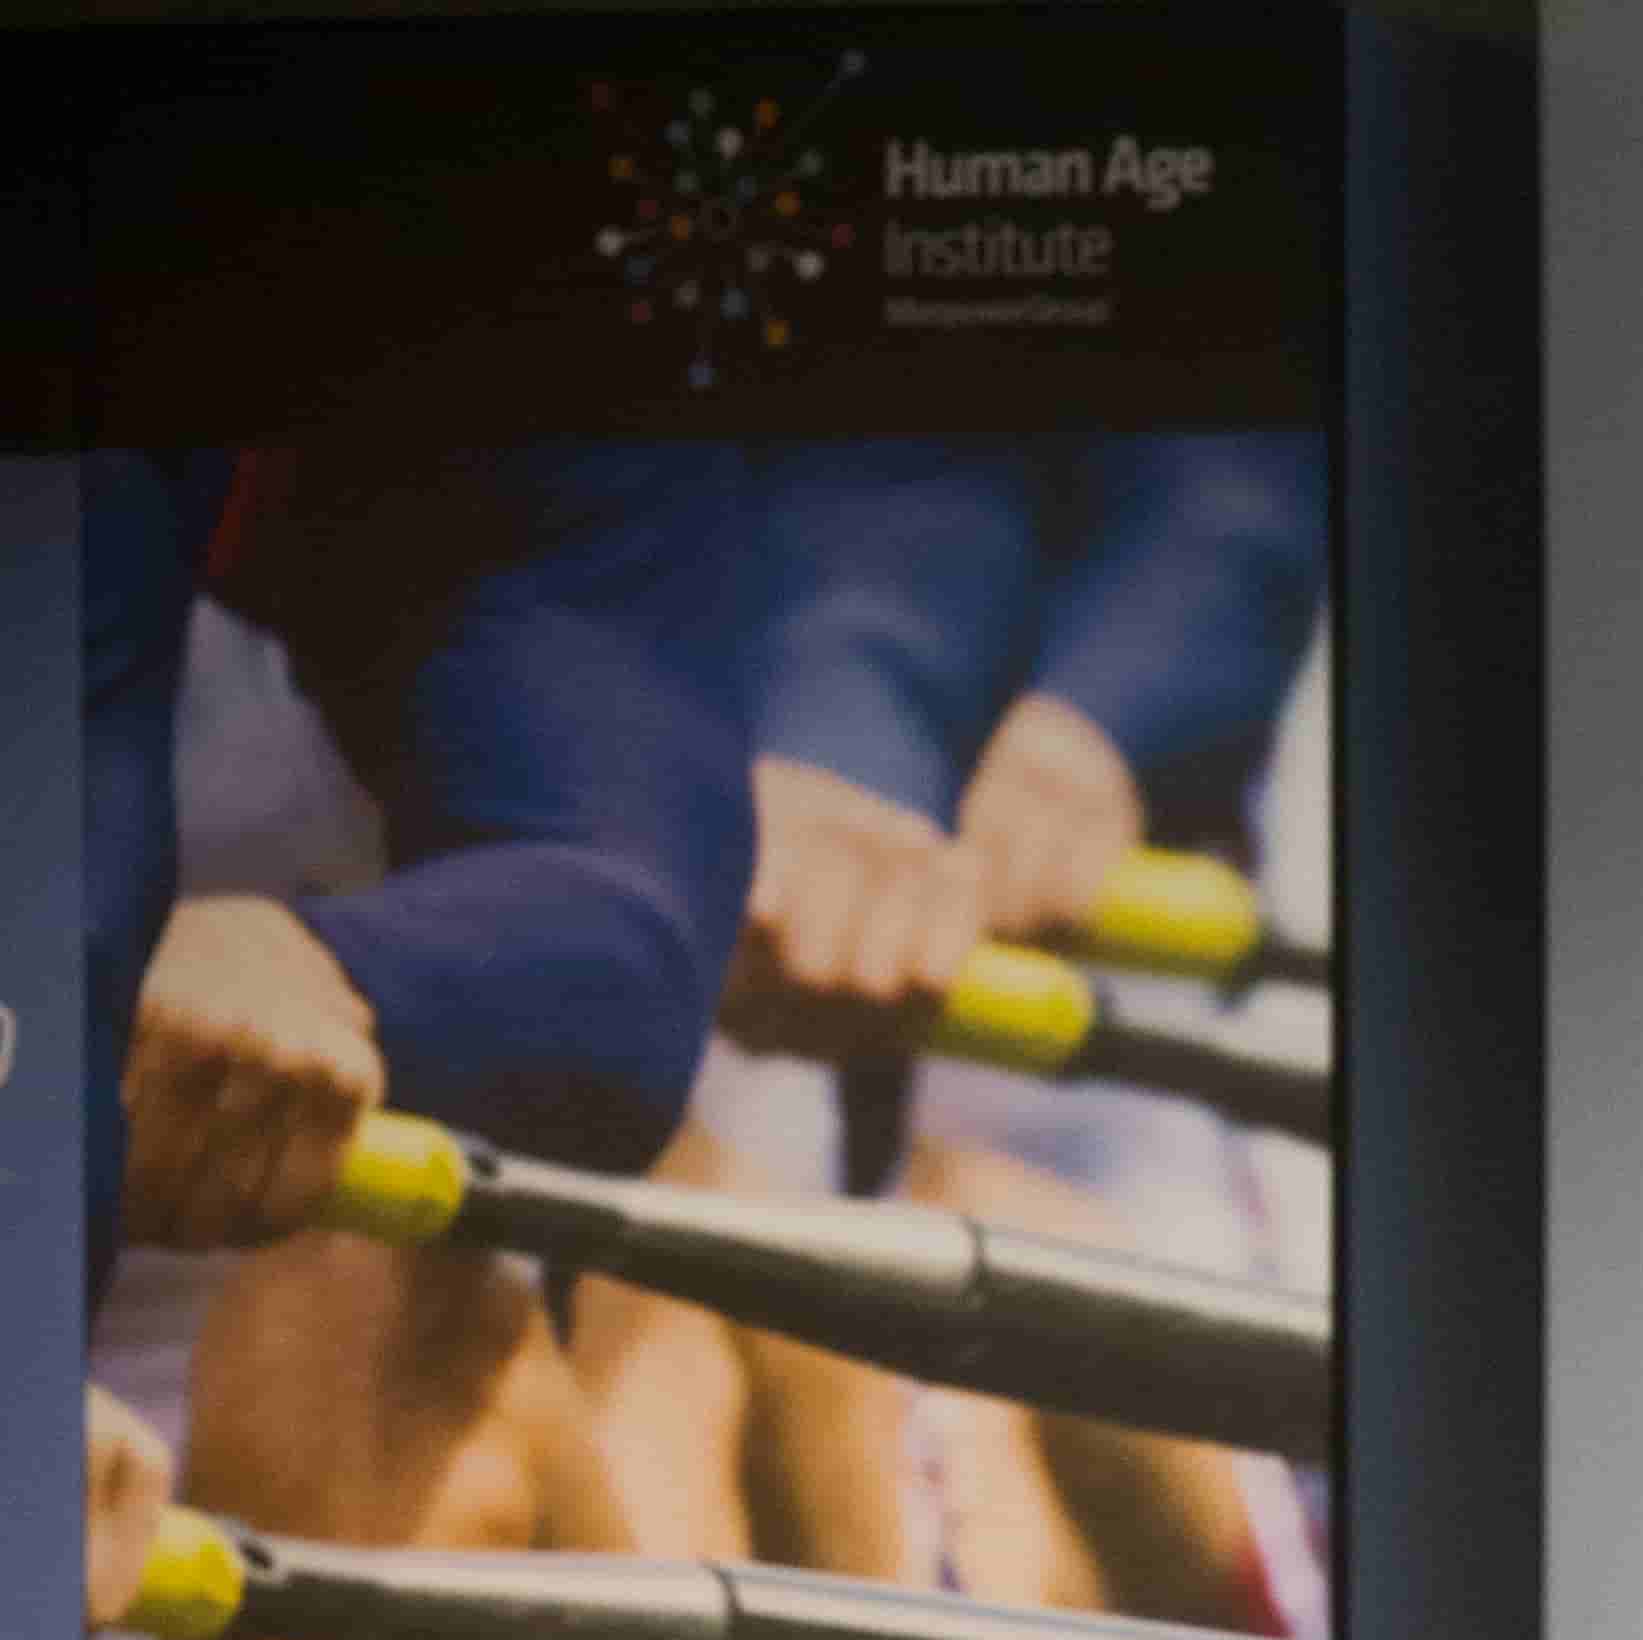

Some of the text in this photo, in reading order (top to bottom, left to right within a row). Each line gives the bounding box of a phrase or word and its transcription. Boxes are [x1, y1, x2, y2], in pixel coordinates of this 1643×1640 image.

[884, 132, 1216, 213] Human Age
[882, 216, 1114, 277] Institute
